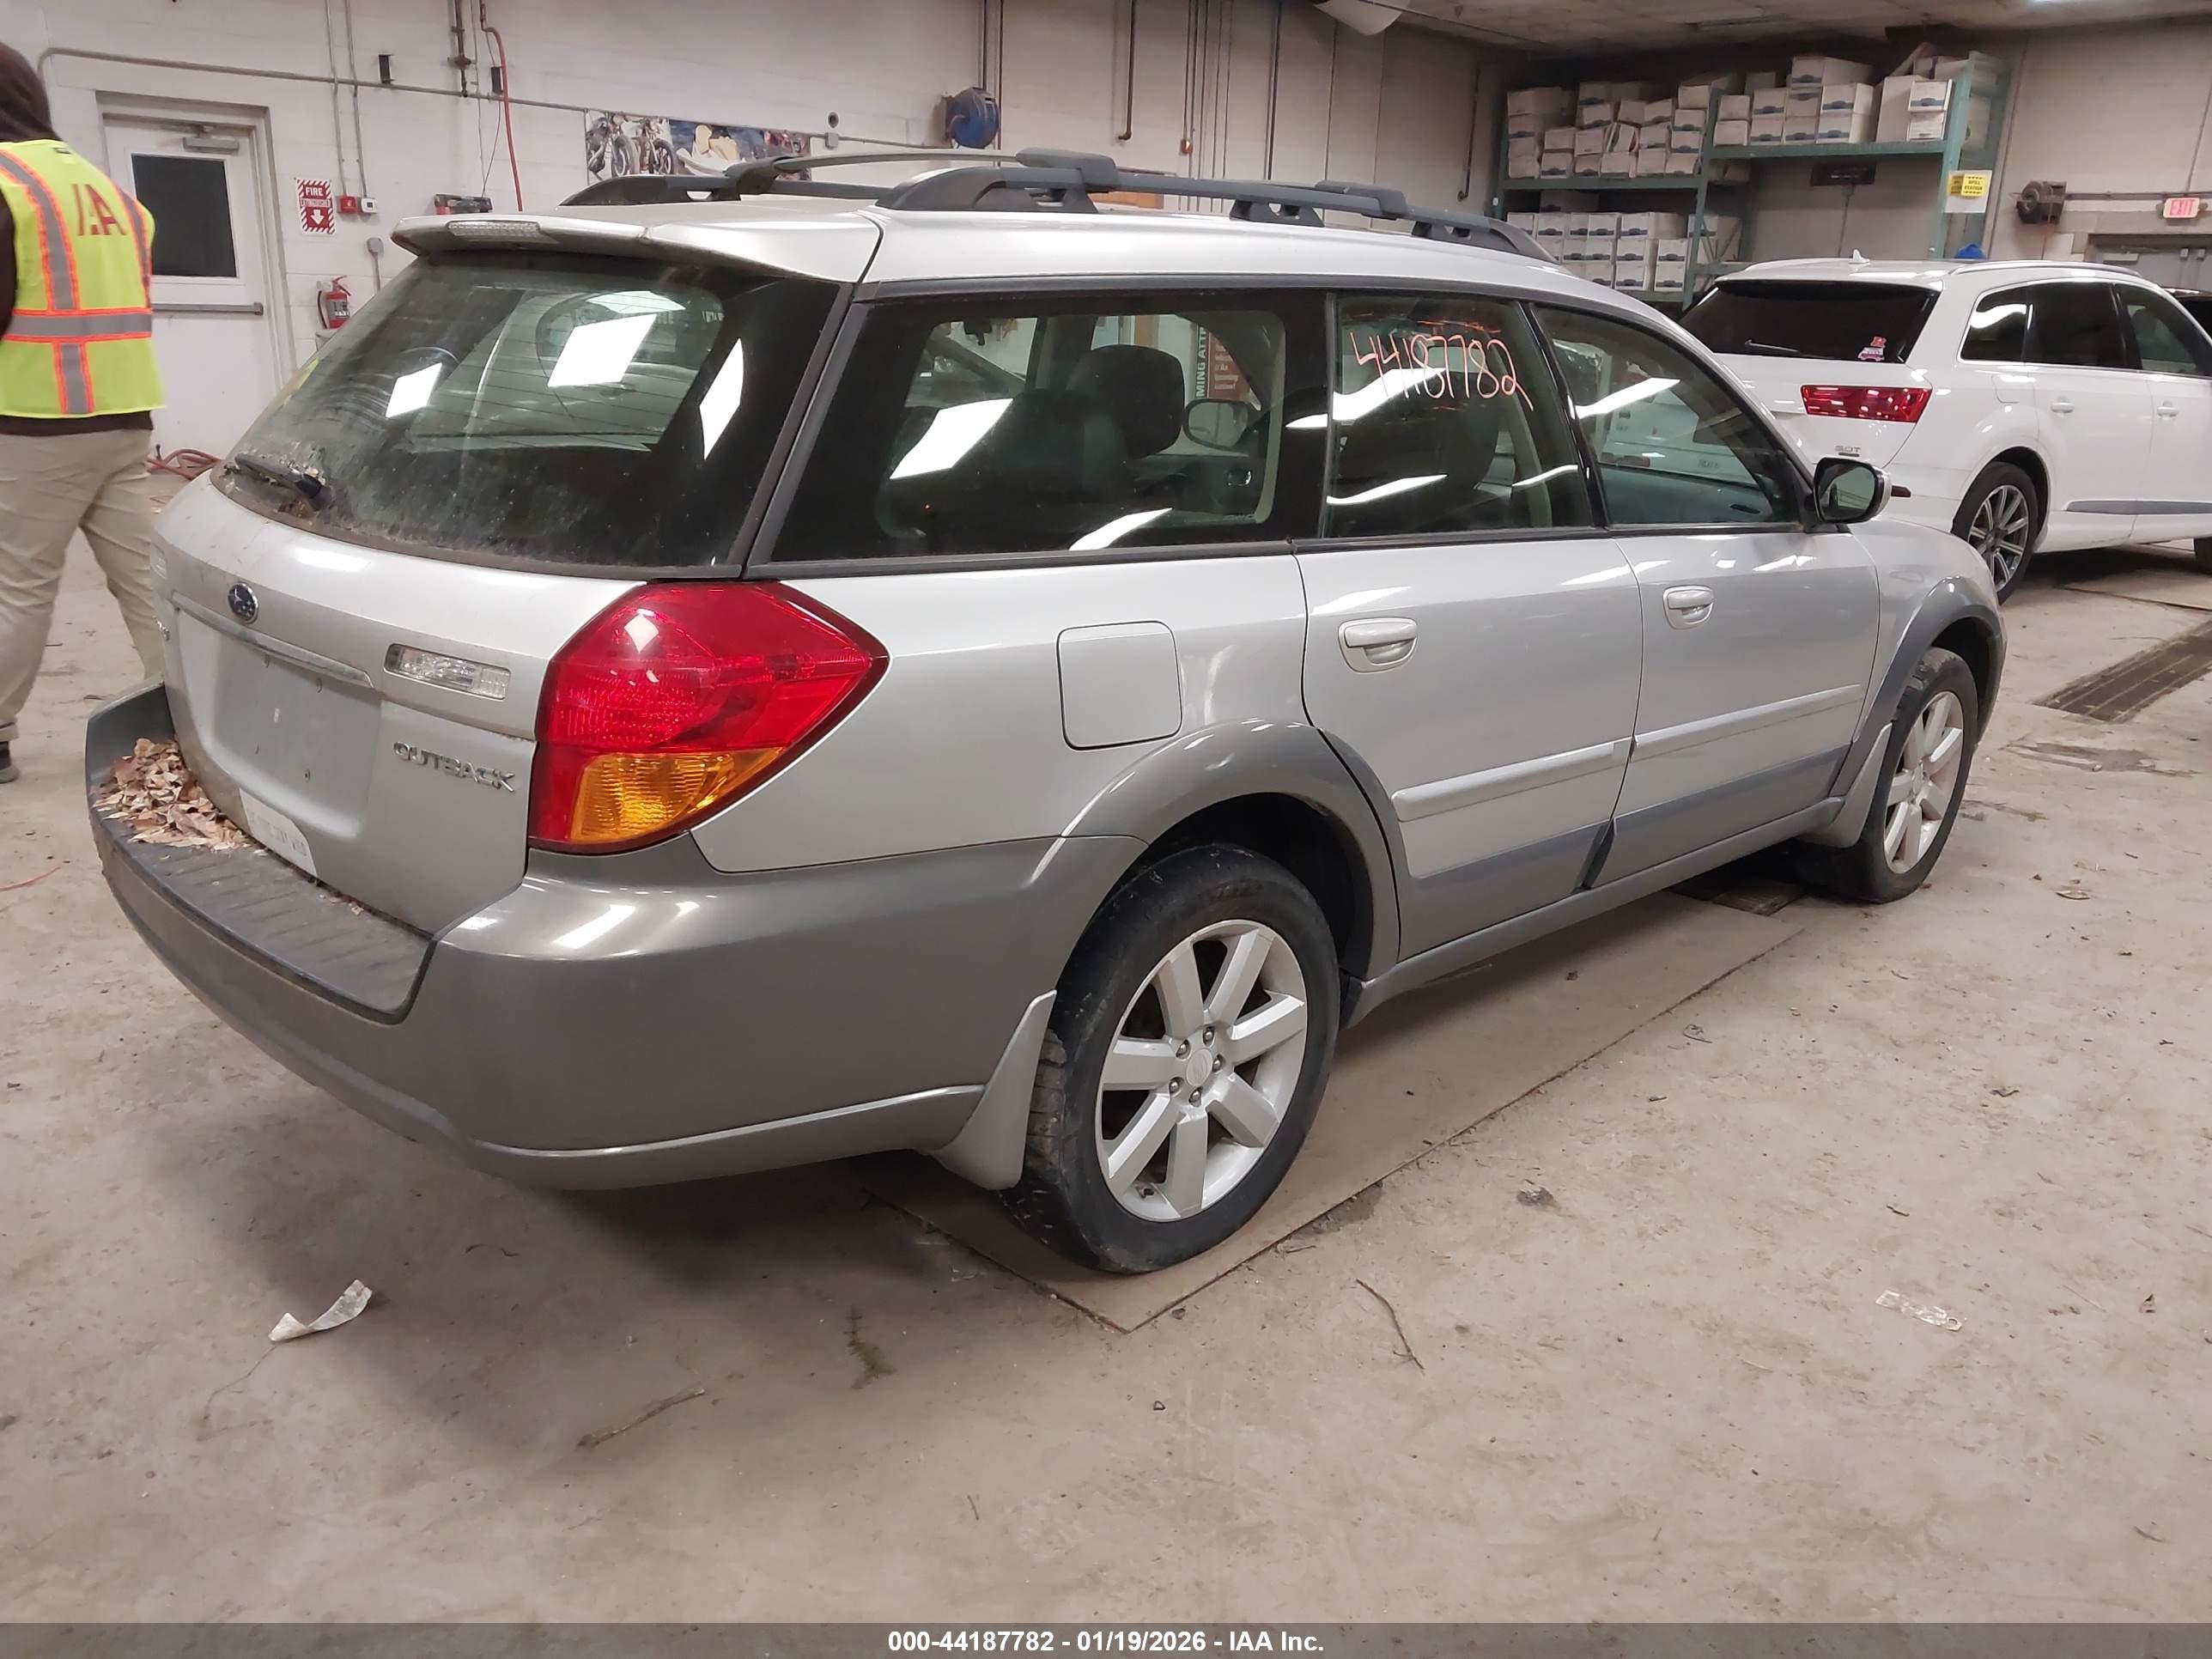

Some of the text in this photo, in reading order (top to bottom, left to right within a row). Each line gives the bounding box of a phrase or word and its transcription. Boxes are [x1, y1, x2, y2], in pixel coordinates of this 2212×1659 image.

[305, 186, 325, 197] FIRE
[2170, 198, 2195, 216] EXIT
[1349, 329, 1534, 411] 44187782
[393, 741, 515, 793] OUTBACK
